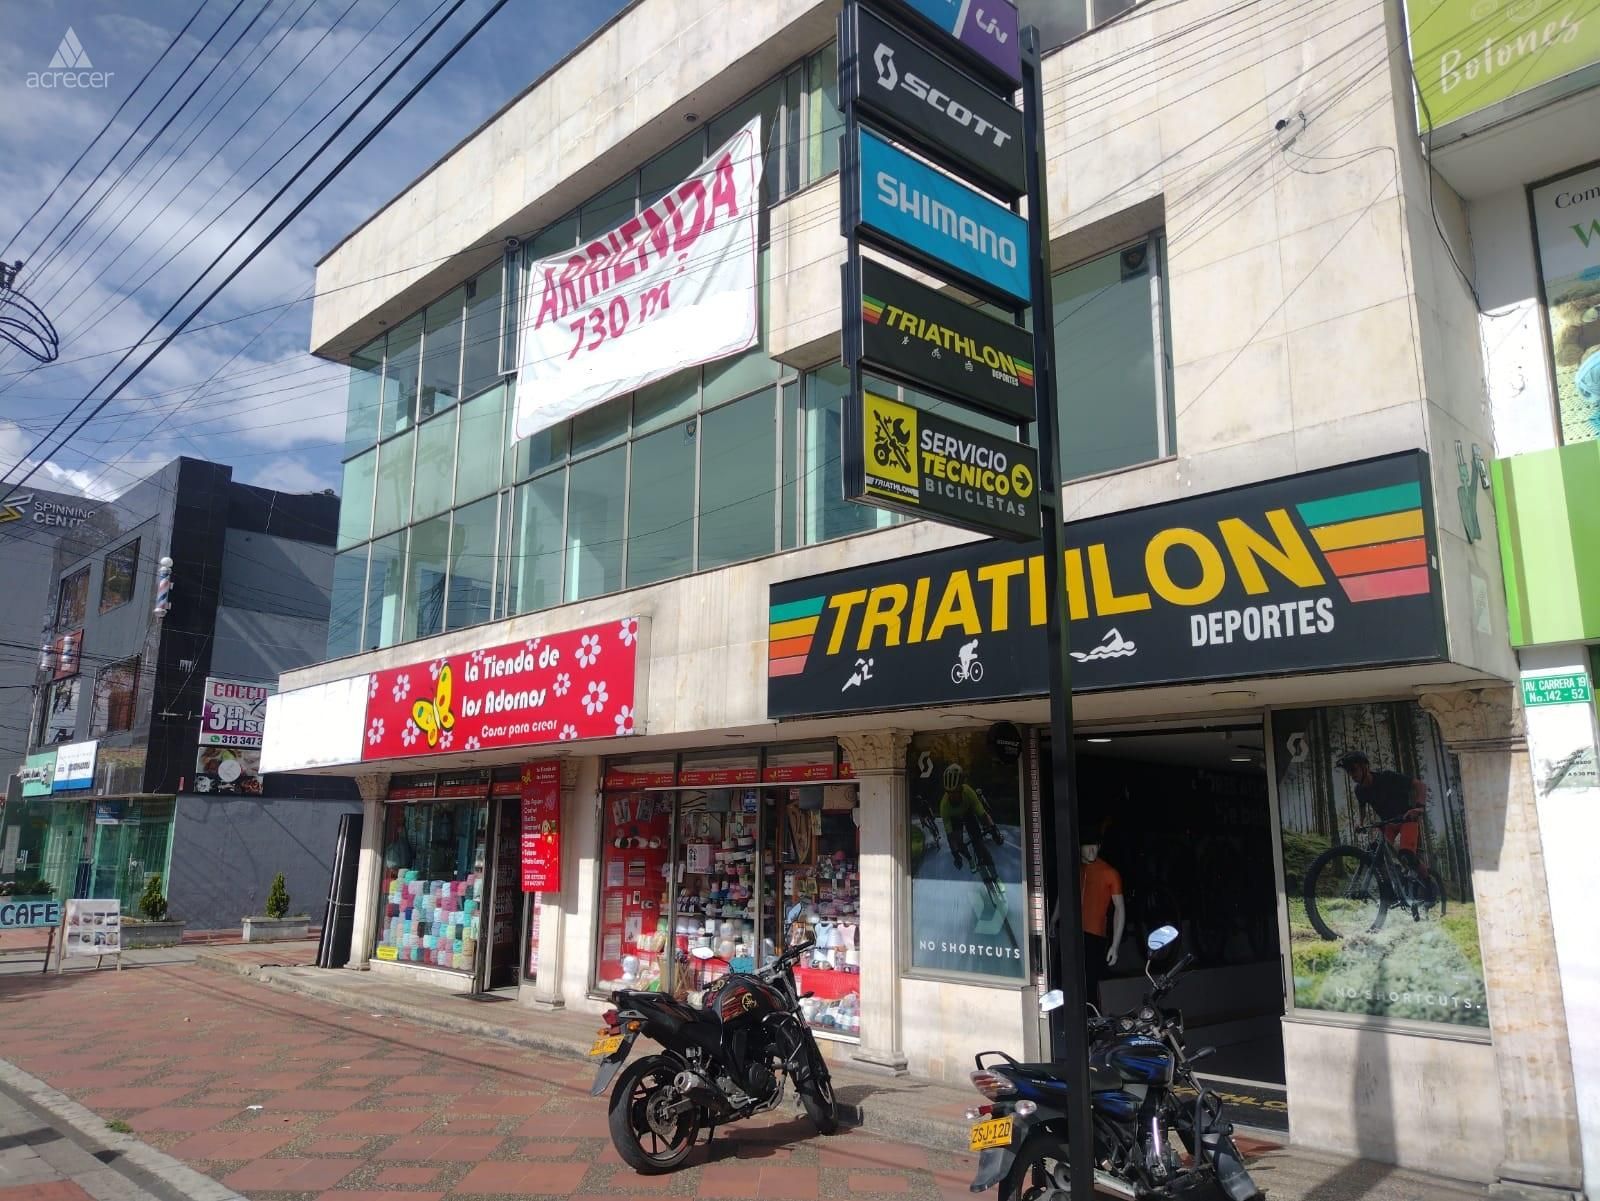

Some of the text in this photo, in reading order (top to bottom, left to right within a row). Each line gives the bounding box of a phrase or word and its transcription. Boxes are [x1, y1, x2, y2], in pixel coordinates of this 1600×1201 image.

[1440, 11, 1583, 94] Botones
[900, 72, 1012, 148] SCOTT
[877, 171, 1017, 268] SHIMANO
[535, 151, 738, 330] ARRIENDA
[568, 295, 630, 360] 730
[886, 304, 1018, 377] TRIATHLON
[992, 369, 1019, 386] DEPORTES
[920, 429, 1008, 473] SERVICIO
[922, 450, 1010, 495] TÉCNICO
[926, 478, 1026, 517] BICICLETAS
[825, 509, 1326, 656] TRIATHLON
[1191, 598, 1335, 647] DEPORTES
[483, 651, 534, 678] Tienda
[539, 645, 560, 667] de
[485, 688, 547, 713] Adornos
[1525, 676, 1586, 692] AV. CARRERA 19
[1571, 688, 1585, 699] 52
[222, 735, 237, 744] 313
[482, 719, 558, 738] Cosas para crear
[0, 903, 58, 925] CAFE
[919, 940, 1021, 959] NO SHORTCUTS
[1335, 987, 1357, 998] NO
